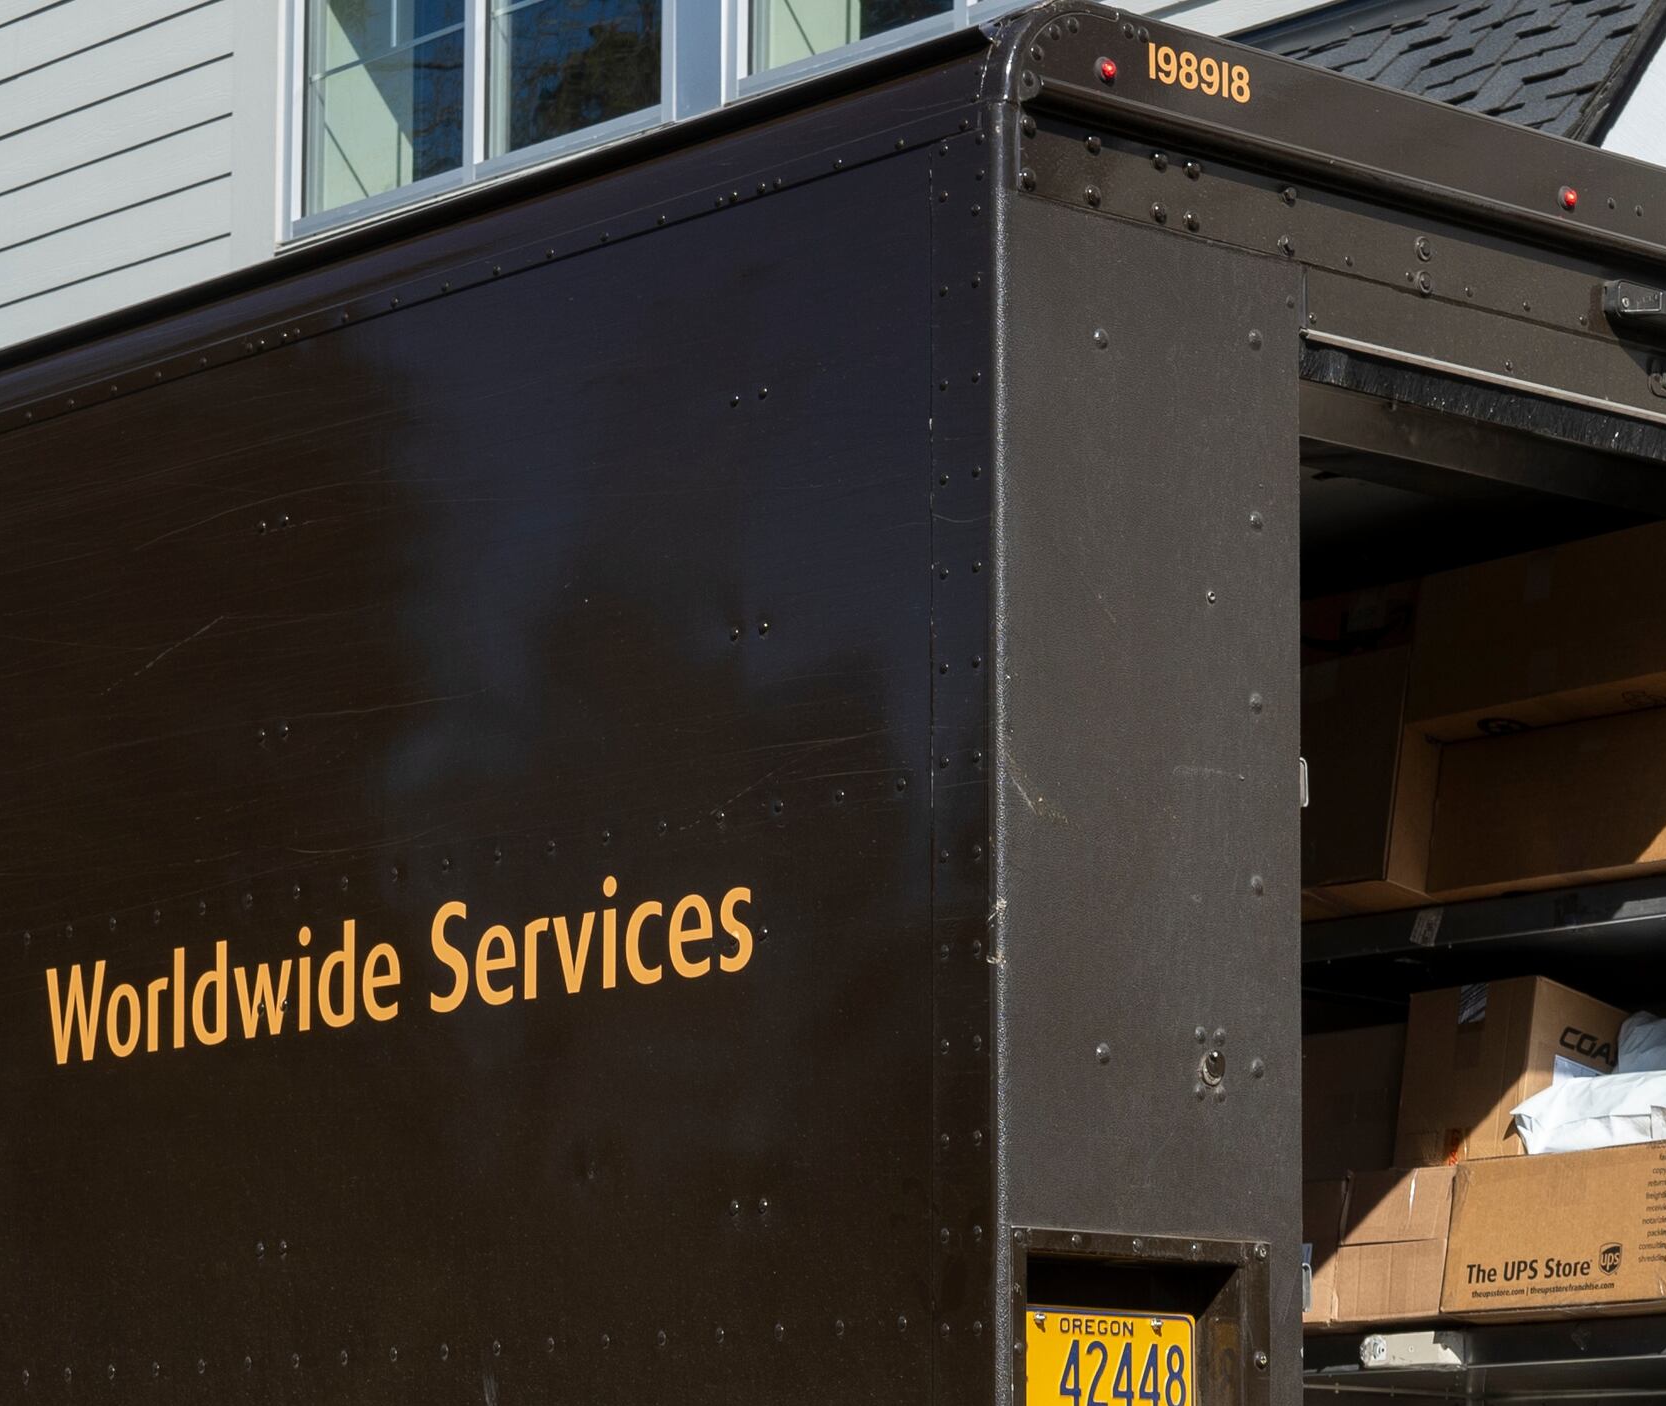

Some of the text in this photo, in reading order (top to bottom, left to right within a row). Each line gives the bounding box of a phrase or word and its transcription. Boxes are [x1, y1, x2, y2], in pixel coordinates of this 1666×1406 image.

[1148, 42, 1251, 104] 198918
[46, 875, 754, 1065] Worldwide Services
[1559, 1026, 1617, 1067] COA
[1467, 1257, 1591, 1285] The UPS Store
[1060, 1317, 1134, 1337] OREGON
